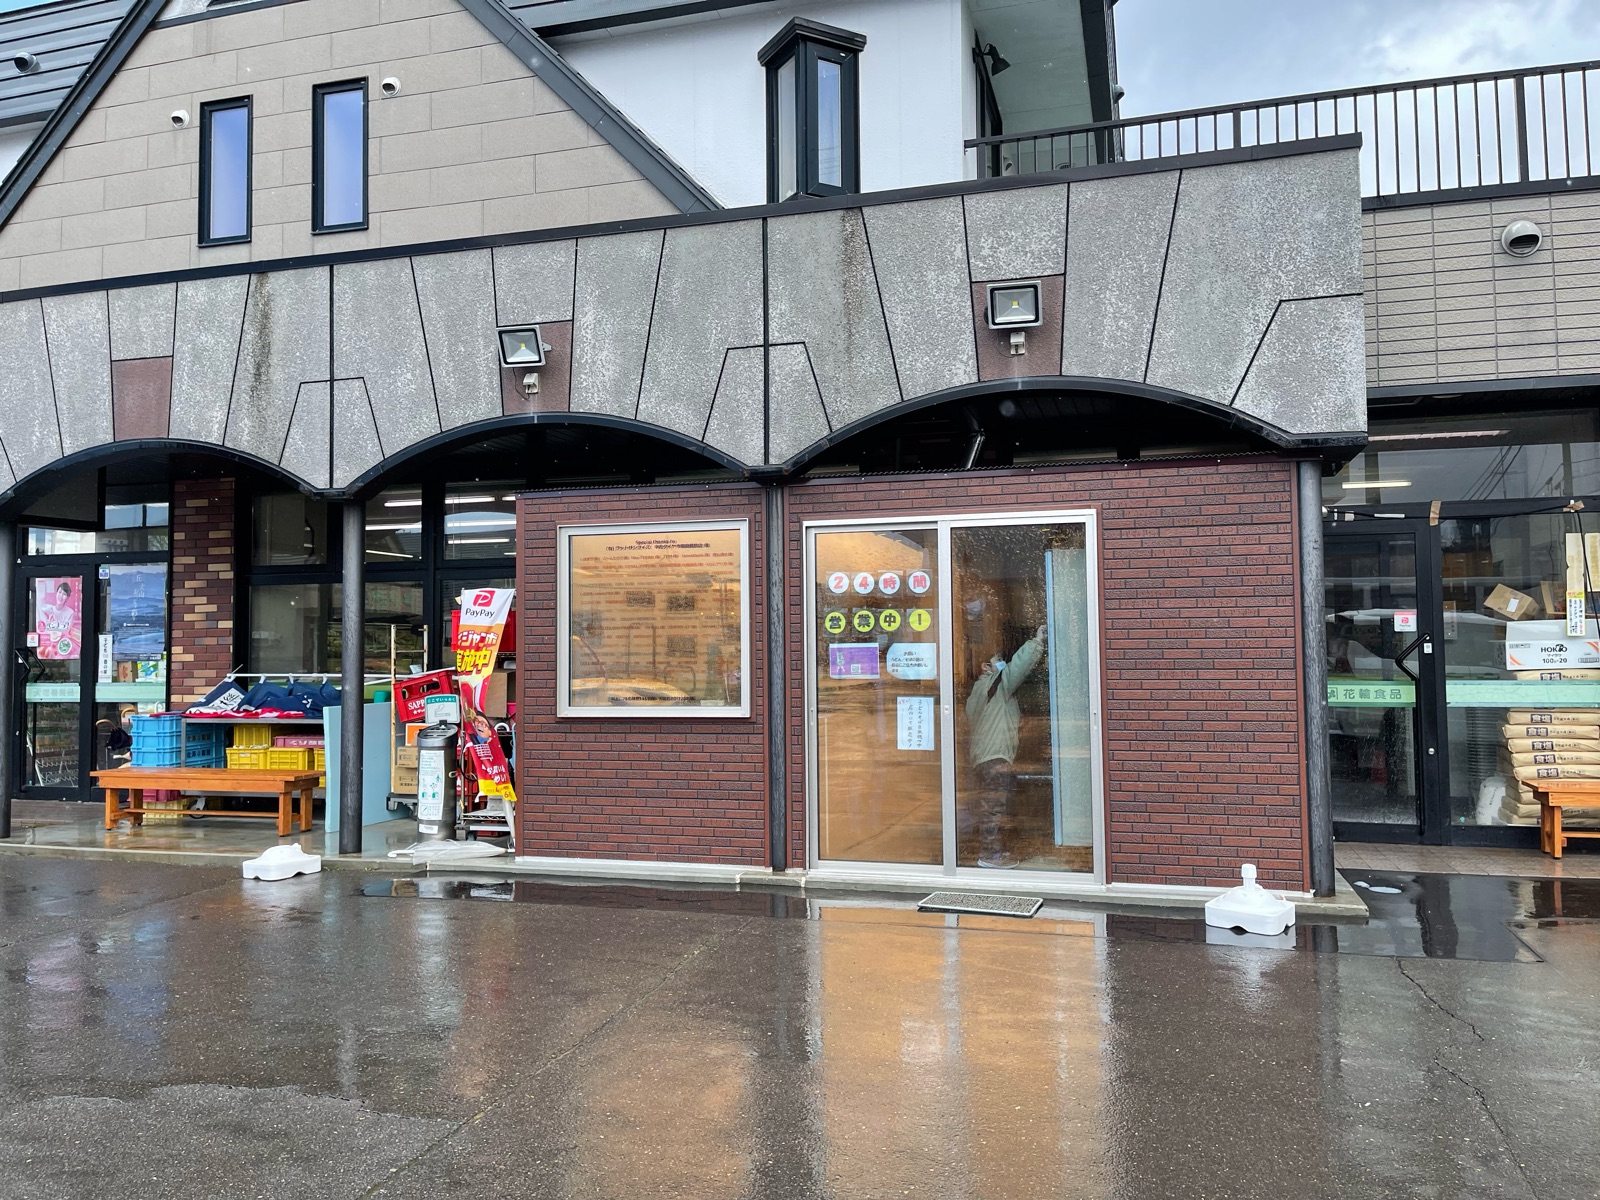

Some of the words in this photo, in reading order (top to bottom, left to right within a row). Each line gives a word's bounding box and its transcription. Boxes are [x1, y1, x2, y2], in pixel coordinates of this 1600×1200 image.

[833, 575, 927, 590] 24時間
[465, 608, 495, 618] PayPay
[1343, 688, 1402, 700] 花輪食品
[408, 699, 425, 711] SAPP
[1532, 714, 1551, 722] 食塩
[1528, 728, 1547, 736] 食塩
[1533, 741, 1552, 749] 食塩
[1535, 755, 1554, 763] 食塩
[1538, 768, 1557, 777] 食塩
